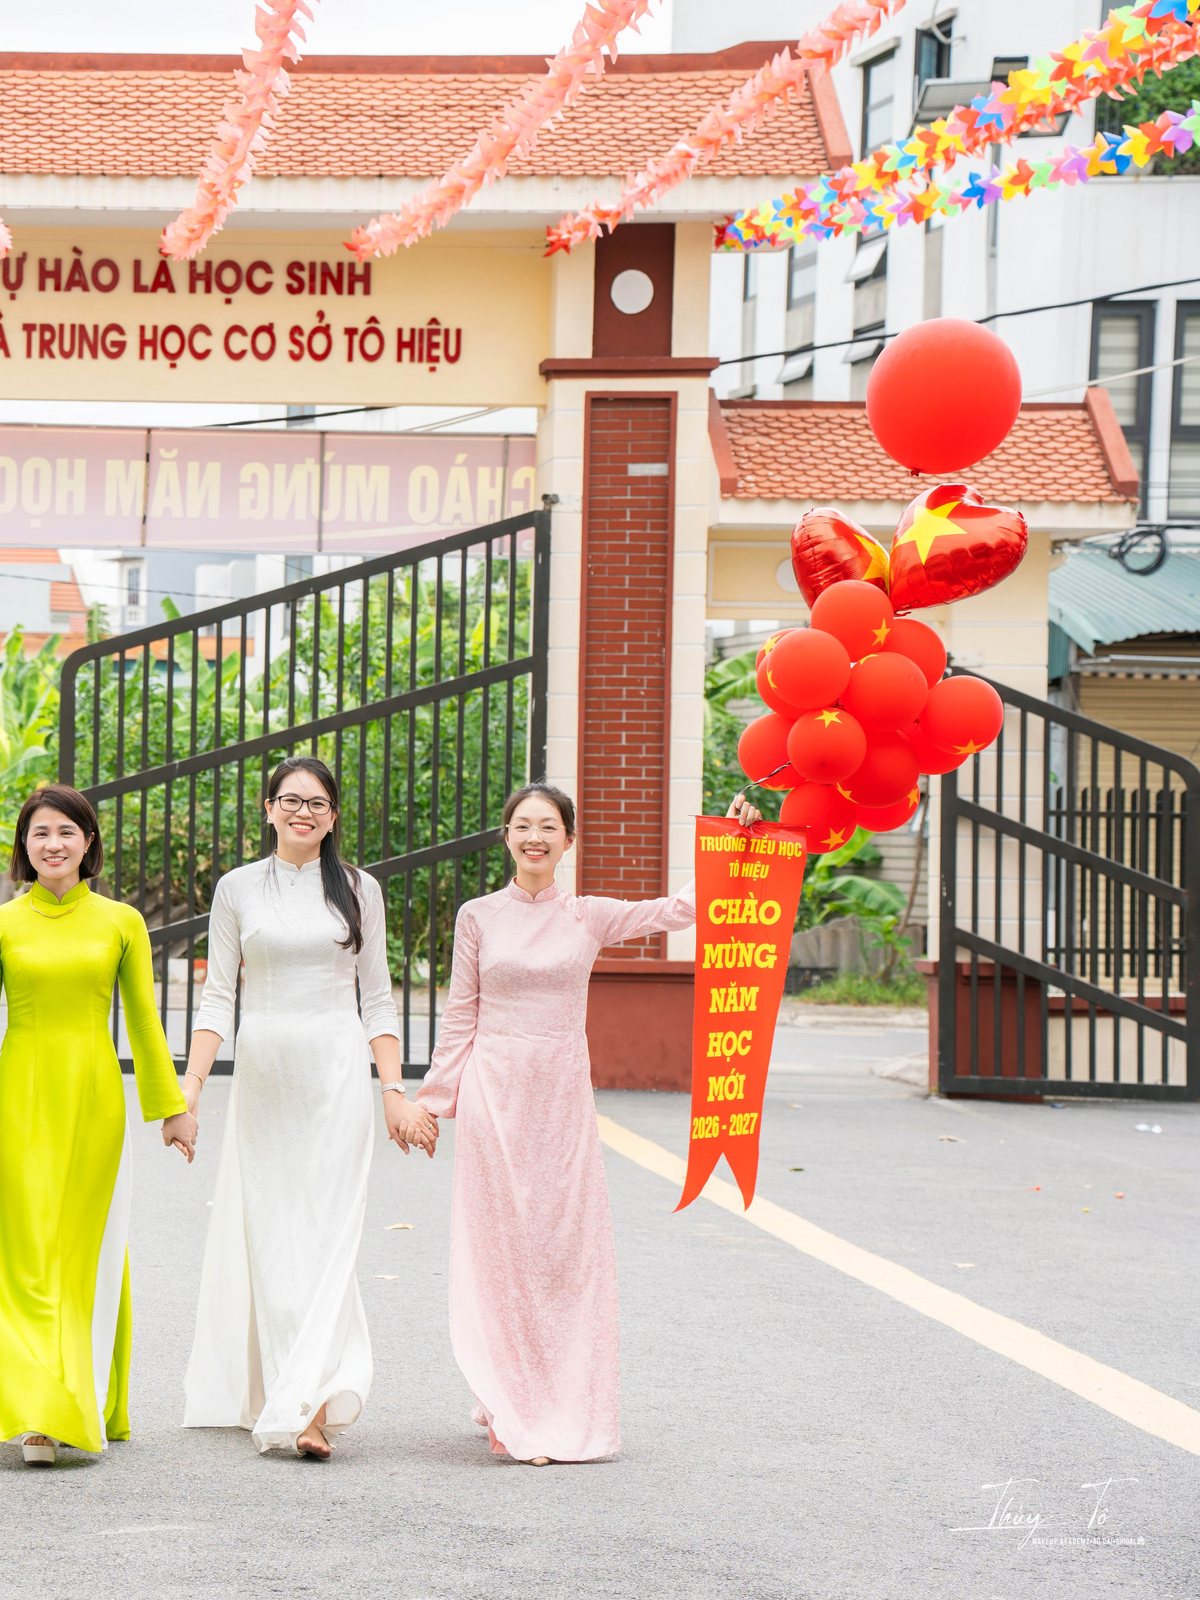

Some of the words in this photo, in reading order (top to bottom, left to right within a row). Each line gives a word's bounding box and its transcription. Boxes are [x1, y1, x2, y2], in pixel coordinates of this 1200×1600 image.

[38, 246, 120, 293] HÀO
[189, 260, 274, 304] HỌC
[286, 261, 372, 296] SINH
[22, 323, 127, 360] TRUNG
[139, 324, 212, 368] HỌC
[224, 323, 277, 361] CƠ
[288, 310, 333, 362] SỞ
[344, 316, 385, 362] TÔ
[397, 317, 462, 372] HIỆU
[700, 834, 747, 852] TRƯỜNG
[750, 834, 777, 855] TIỂU
[778, 841, 802, 859] HỌC
[729, 860, 739, 877] TÔ
[741, 861, 769, 881] HIỆU
[708, 891, 781, 926] CHÀO
[702, 936, 777, 969] MỪNG
[709, 981, 759, 1013] NĂM
[707, 1030, 752, 1062] HỌC
[707, 1068, 746, 1102] MỚI
[692, 1116, 719, 1139] 2026
[729, 1113, 758, 1136] 2027
